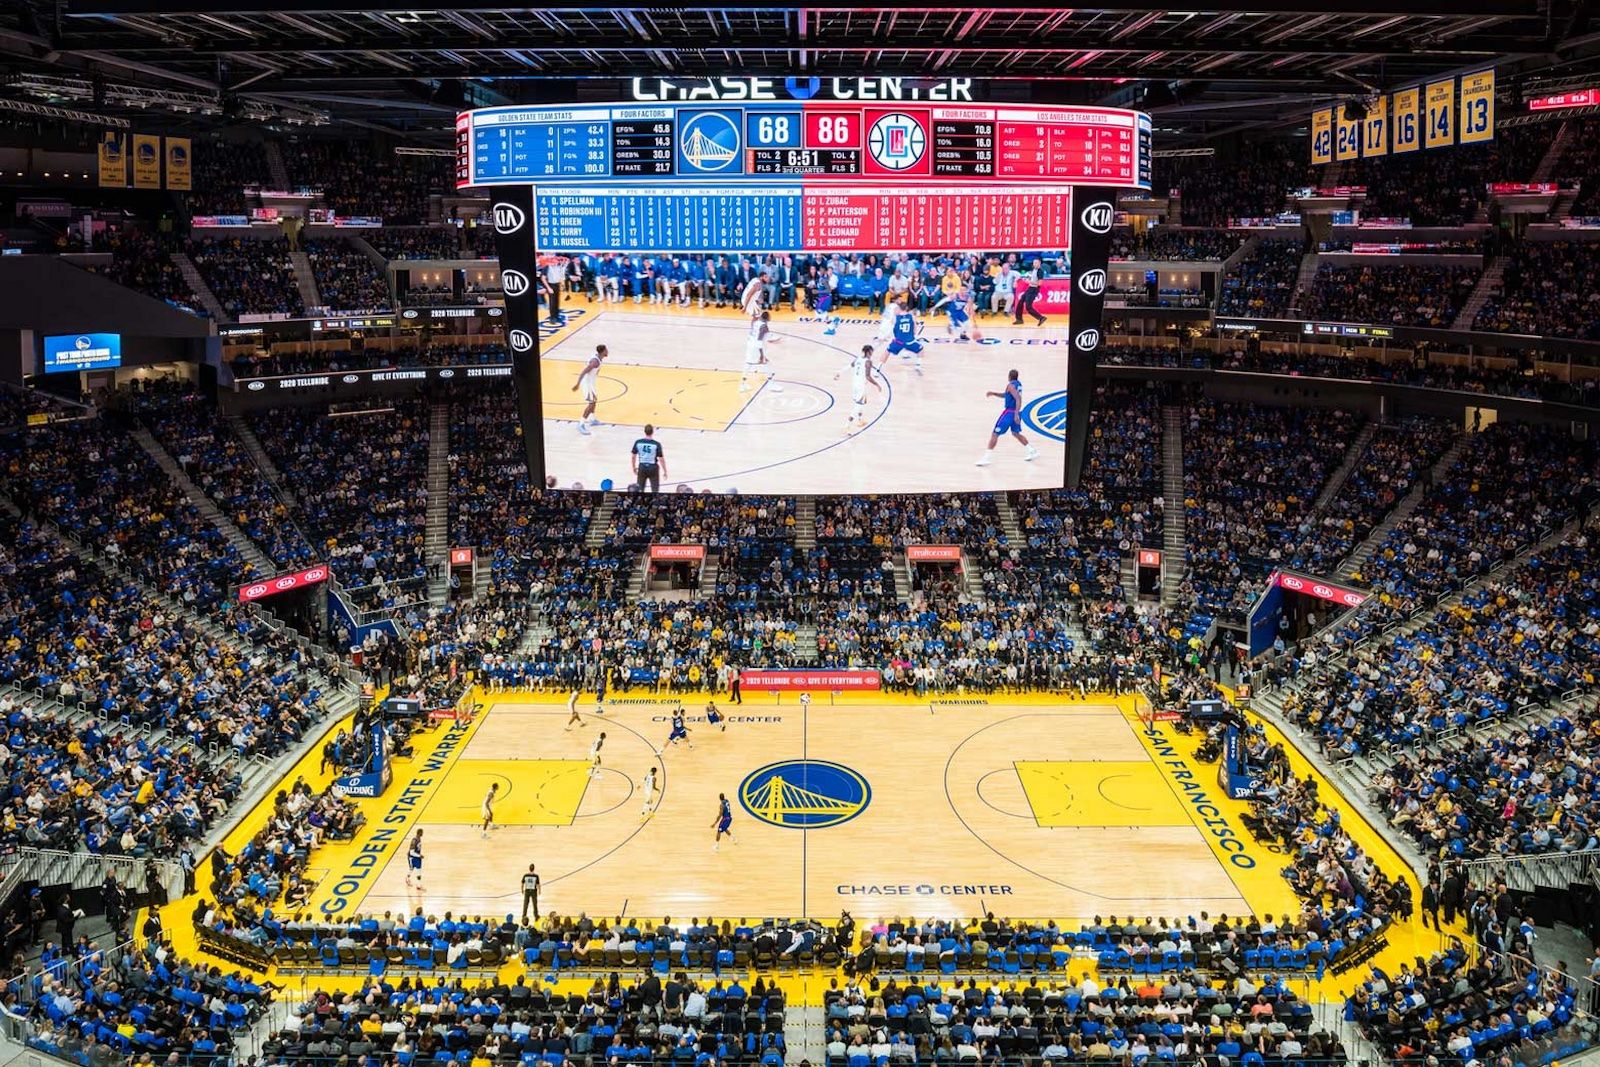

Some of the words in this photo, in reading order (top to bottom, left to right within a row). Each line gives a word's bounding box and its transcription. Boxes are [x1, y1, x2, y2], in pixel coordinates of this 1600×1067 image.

[633, 77, 776, 100] CHASE
[520, 114, 536, 122] STATE
[638, 110, 666, 118] FACTORS
[942, 110, 960, 118] FOUR
[960, 110, 987, 118] FACTORS
[1466, 98, 1488, 134] 13
[1430, 106, 1448, 139] 14
[588, 126, 603, 134] 42.4
[653, 124, 670, 133] 45.8
[758, 117, 789, 144] 68
[818, 117, 848, 144] 86
[1398, 114, 1414, 144] 16
[1338, 124, 1356, 153] 24
[1368, 120, 1382, 149] 17
[547, 140, 553, 148] 11
[588, 139, 604, 147] 33.3
[654, 138, 670, 147] 14.3
[1314, 130, 1330, 156] 42
[547, 152, 553, 161] 11
[588, 151, 604, 160] 38.3
[653, 150, 670, 159] 30.0
[775, 151, 781, 160] 2
[788, 151, 818, 166] 6:51
[850, 151, 855, 160] 4
[584, 164, 604, 172] 100.0
[655, 163, 670, 172] 21.7
[775, 164, 781, 172] 2
[850, 164, 855, 172] 5
[975, 164, 991, 173] 45.8
[560, 208, 594, 216] ROBINSON
[1089, 208, 1110, 226] KIA
[828, 218, 862, 226] BEVERLEY
[828, 228, 859, 236] LEONARD
[543, 238, 548, 246] 0
[561, 238, 590, 246] RUSSELL
[827, 238, 855, 246] SHAMET
[1085, 275, 1103, 290] KIA
[899, 323, 910, 332] 40
[372, 373, 385, 381] GIVE
[392, 371, 426, 380] EVERYTHING
[280, 379, 296, 388] 2020
[297, 377, 329, 387] TELLURIDE
[642, 445, 651, 453] 45
[657, 548, 696, 556] realtor.com
[914, 548, 952, 556] realtor.com
[337, 785, 374, 796] SPALDING
[1143, 728, 1178, 756] SAN
[1165, 760, 1256, 869] FRANCISCO
[320, 828, 398, 914] GOLDEN
[384, 777, 432, 824] STATE
[837, 885, 910, 895] CHASE
[940, 885, 1012, 895] CENTER
